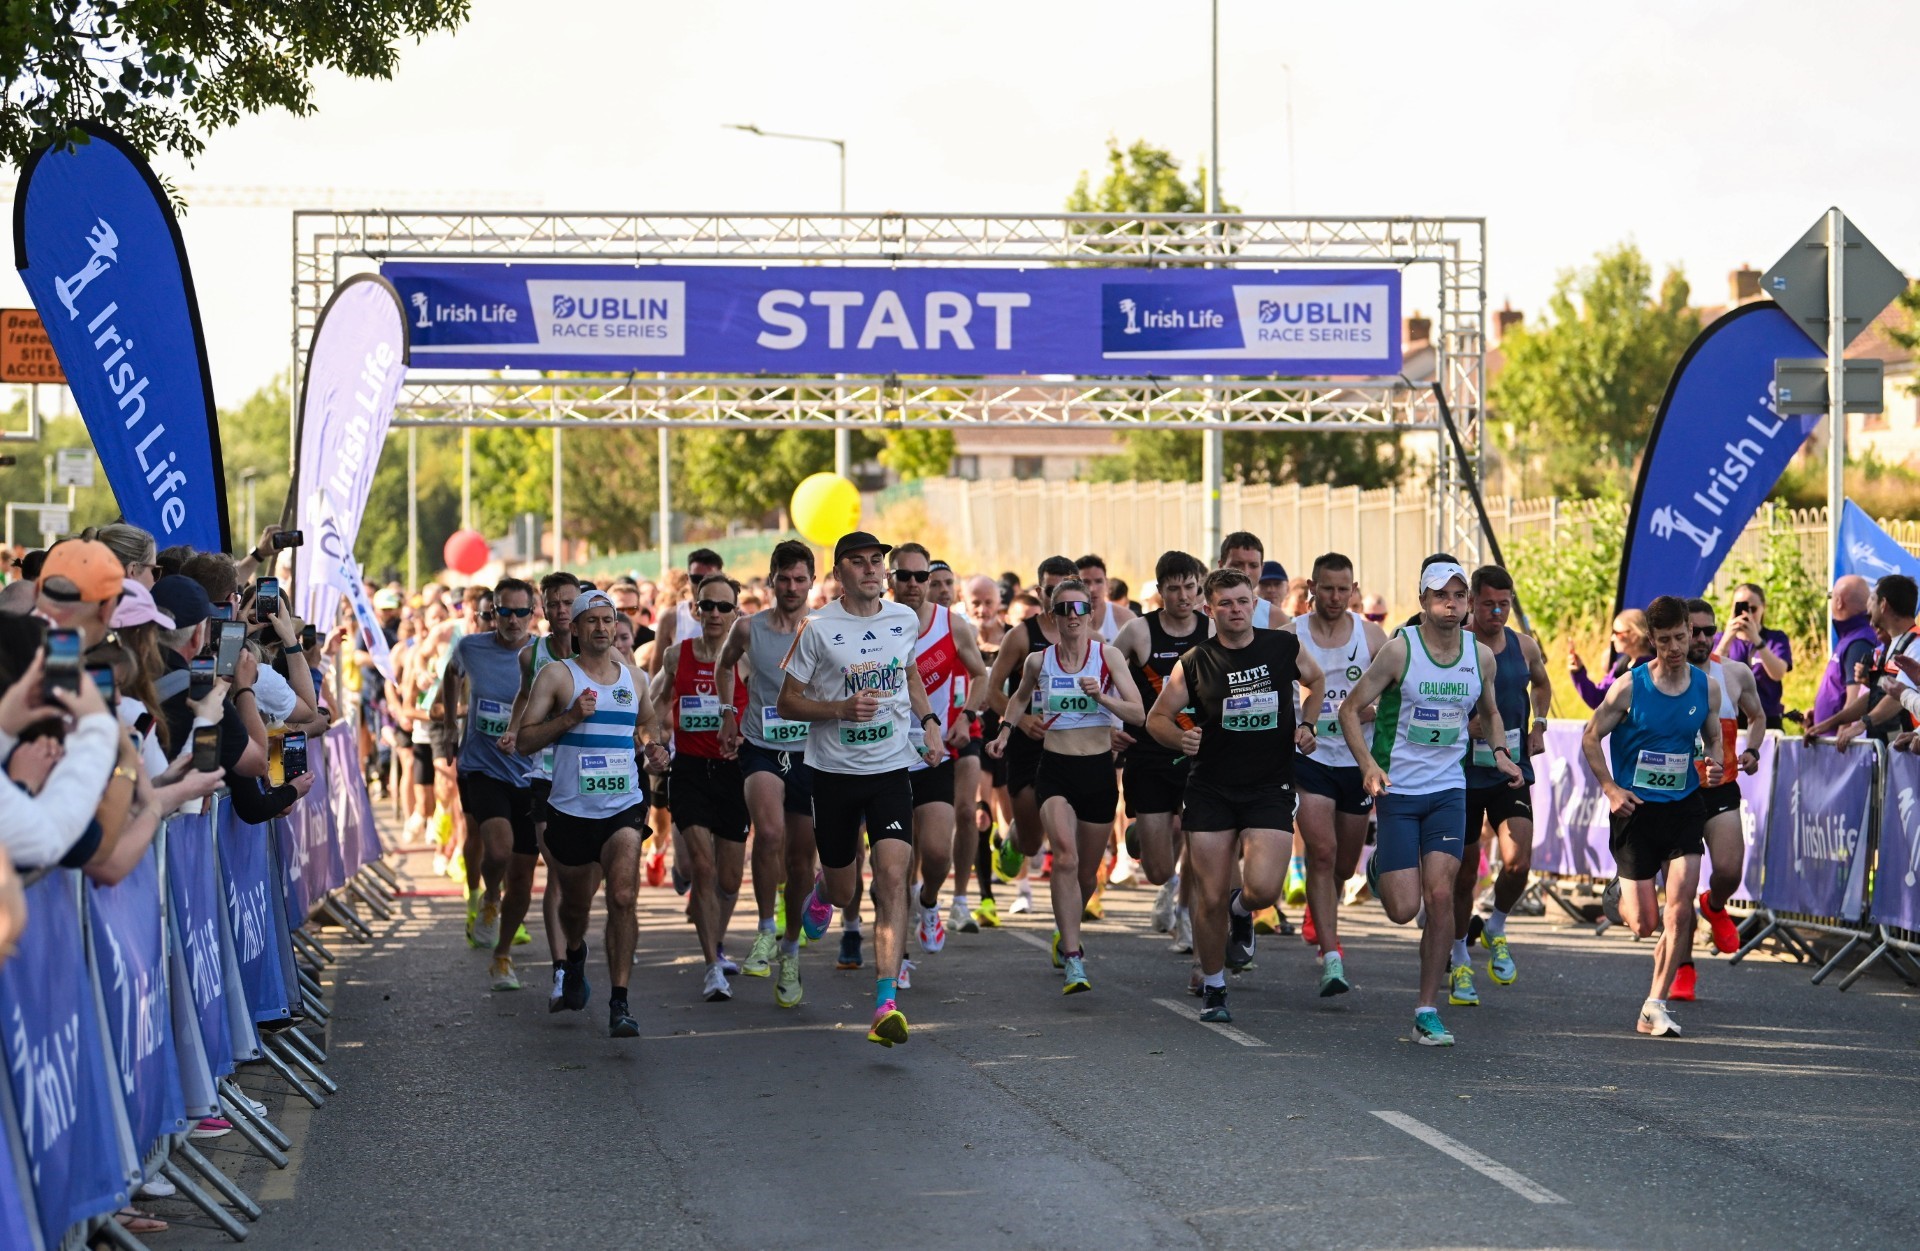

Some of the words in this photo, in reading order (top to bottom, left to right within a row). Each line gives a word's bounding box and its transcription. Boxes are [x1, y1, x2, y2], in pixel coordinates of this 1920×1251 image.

[436, 304, 477, 323] Irish
[482, 304, 518, 323] Life
[552, 295, 668, 320] DUBLIN
[1258, 300, 1372, 324] DUBLIN
[756, 289, 1031, 350] START
[1144, 310, 1185, 328] Irish
[1188, 310, 1224, 329] Life
[552, 323, 599, 338] RACE
[604, 324, 668, 338] SERIES
[1258, 328, 1304, 342] RACE
[1309, 328, 1372, 342] SERIES
[21, 347, 53, 361] SITE
[87, 301, 150, 430] Irish
[135, 423, 187, 535] Life
[330, 415, 370, 498] Irish
[355, 341, 395, 413] Life
[1693, 442, 1764, 516] Irish
[1746, 380, 1789, 439] Li
[924, 671, 940, 688] LUB
[1227, 664, 1270, 685] ELITE
[1418, 681, 1469, 696] CRAUGHWELL
[1060, 697, 1088, 710] 610
[685, 716, 719, 728] 3232
[1228, 714, 1271, 728] 3308
[1327, 721, 1337, 734] 4
[771, 724, 808, 740] 1892
[846, 725, 888, 743] 3430
[1430, 729, 1441, 743] 2
[586, 777, 625, 791] 3458
[1647, 772, 1676, 787] 262
[1801, 812, 1827, 860] Irish
[1826, 813, 1859, 862] Life
